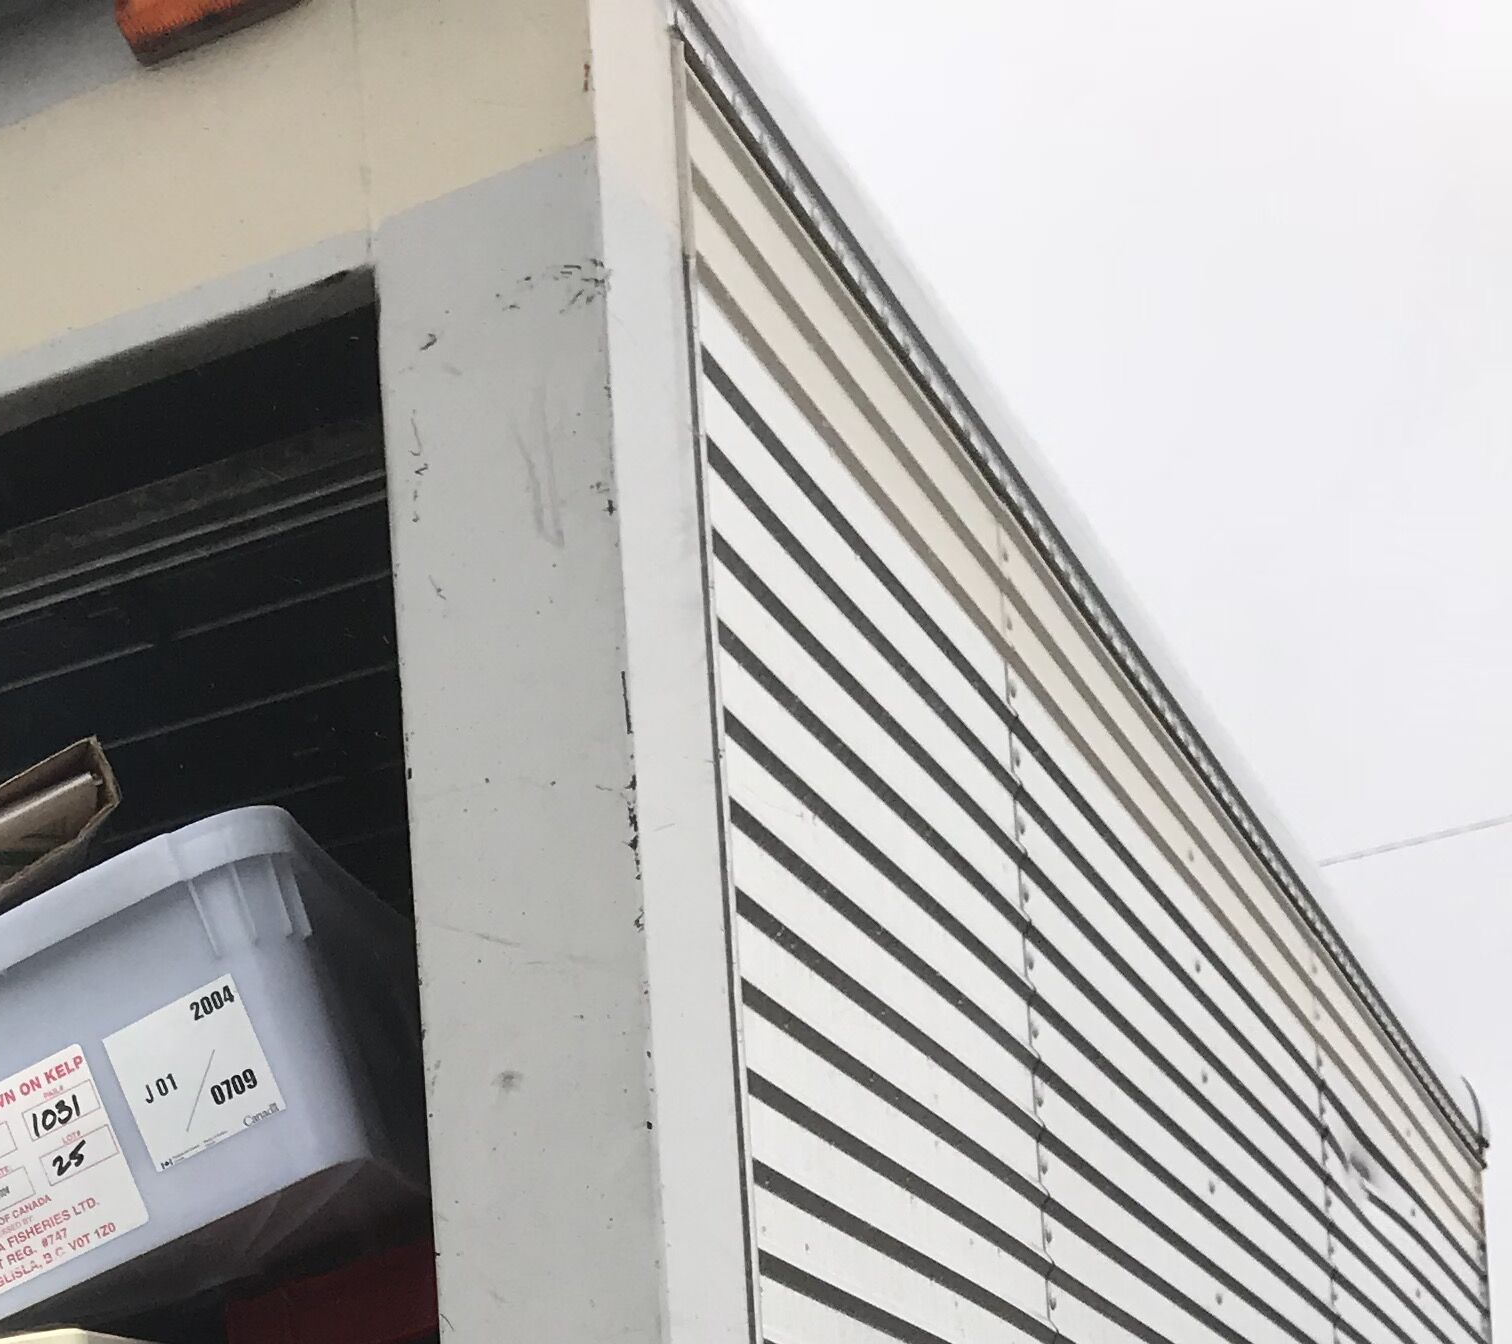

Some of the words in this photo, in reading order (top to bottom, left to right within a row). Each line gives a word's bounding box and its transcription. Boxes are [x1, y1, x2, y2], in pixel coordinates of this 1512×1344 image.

[189, 985, 235, 1021] 2004
[19, 1076, 42, 1096] ON
[44, 1055, 84, 1084] KELP
[210, 1068, 258, 1106] 0709
[32, 1094, 81, 1138] 1031
[52, 1139, 86, 1176] 25
[7, 1210, 71, 1248] FISHERIES
[72, 1197, 100, 1216] LTD.
[12, 1194, 52, 1218] CANADA
[7, 1246, 38, 1266] REG.
[41, 1228, 69, 1249] #747
